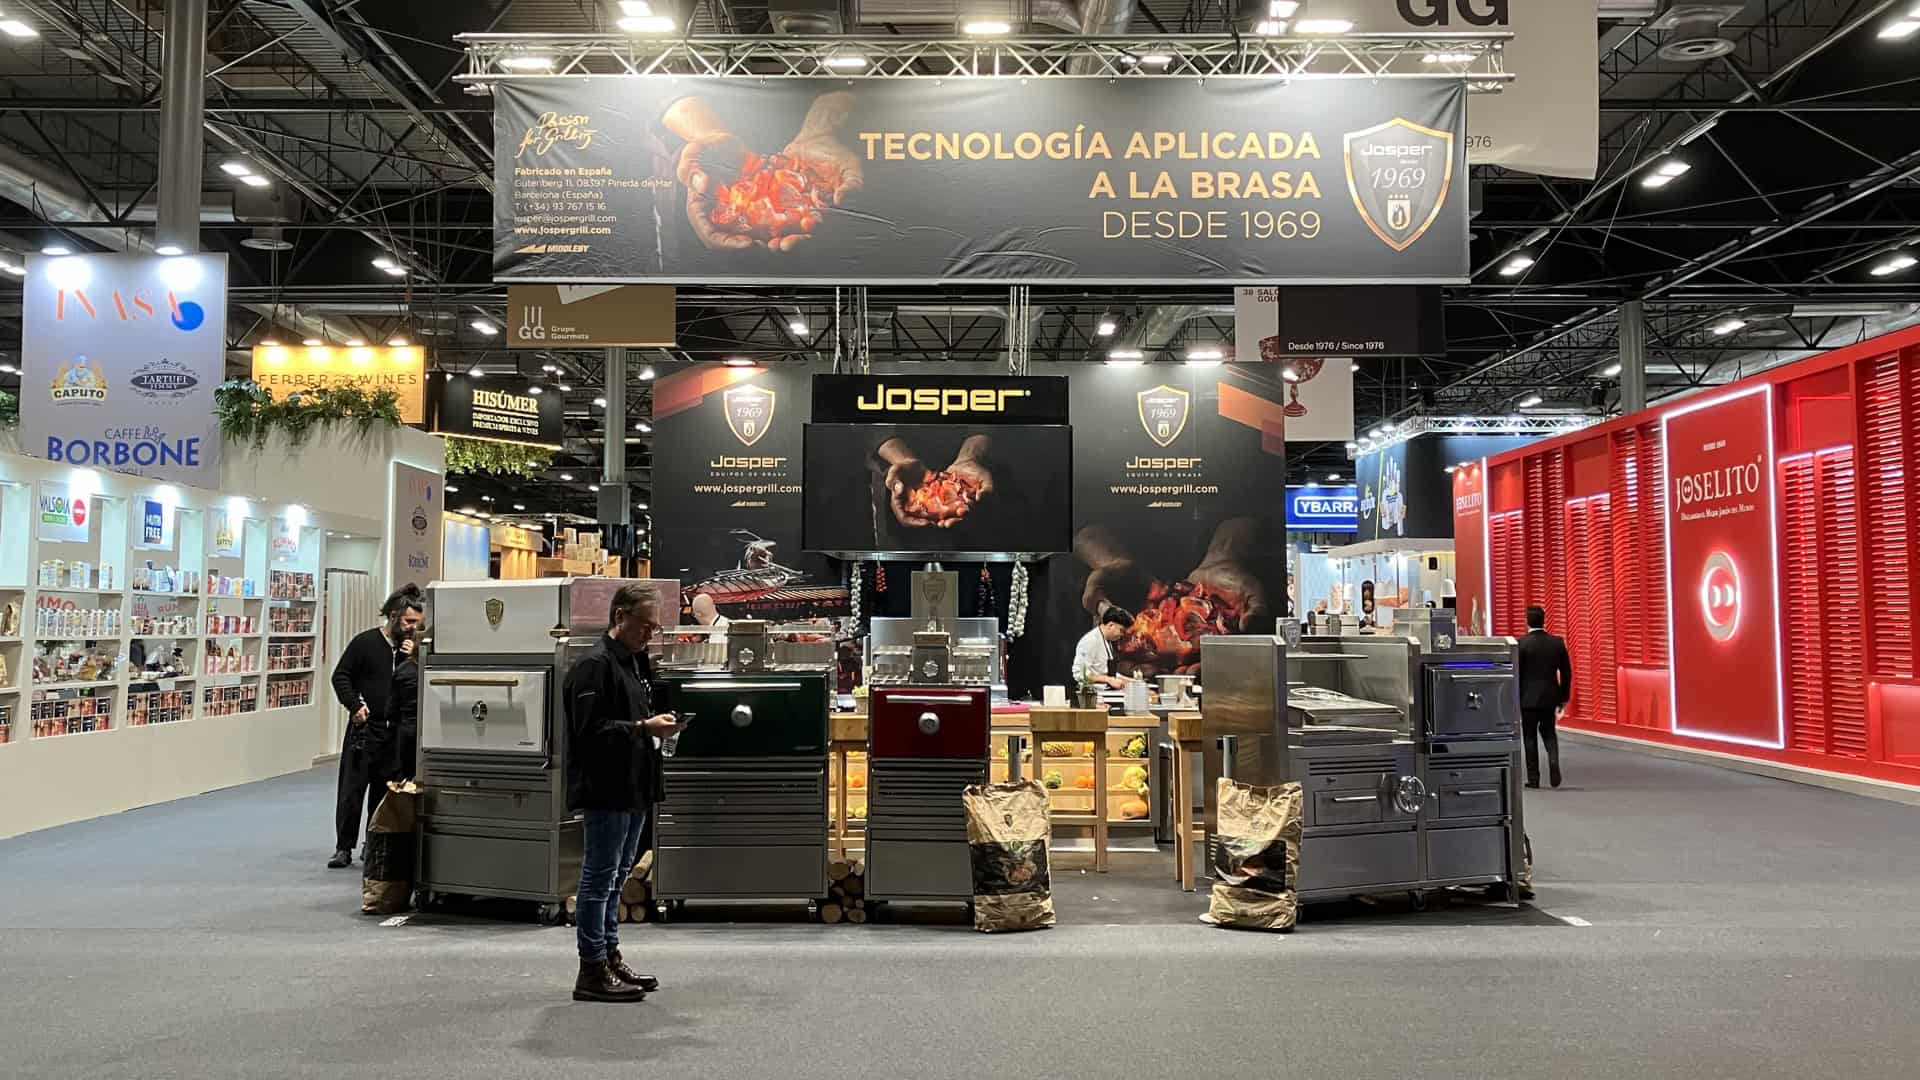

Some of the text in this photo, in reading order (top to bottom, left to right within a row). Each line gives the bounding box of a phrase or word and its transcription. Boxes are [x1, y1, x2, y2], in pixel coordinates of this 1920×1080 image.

[860, 123, 1321, 160] TECNOLOGÍA APLICADA
[1360, 144, 1432, 158] Josper
[514, 167, 612, 179] Fabricado en España
[1371, 168, 1425, 189] 1969
[514, 179, 563, 189] Gutenberg
[576, 179, 605, 188] 08397
[607, 179, 639, 188] Pineda
[655, 180, 673, 188] Mar
[1088, 171, 1321, 199] A LA BRASA
[514, 191, 603, 201] Barcelona (España)
[523, 203, 550, 212] (+34)
[552, 203, 564, 211] 93
[567, 203, 583, 211] 767
[586, 203, 595, 211] 15
[597, 203, 607, 211] 16
[514, 214, 617, 224] josper@jospergrill.com
[1102, 210, 1321, 239] DESDE 1969
[514, 225, 612, 236] www.jospergrill.com
[546, 244, 590, 253] MIDDLEBY
[518, 326, 546, 340] GG
[551, 326, 576, 334] Grupo
[1288, 342, 1314, 350] Desde
[1315, 342, 1334, 350] 1976
[1341, 342, 1364, 350] Since
[1365, 342, 1385, 350] 1976
[360, 374, 418, 385] WINES
[53, 388, 105, 399] CAPUTO
[857, 384, 1025, 415] Josper
[472, 389, 540, 413] HISÚMER
[1151, 407, 1177, 418] 1969
[47, 437, 200, 467] BORBONE
[710, 455, 787, 469] Josper
[1125, 455, 1202, 470] Josper
[694, 483, 802, 495] www.jospergrill.com
[1110, 483, 1219, 495] www.jospergrill.com
[1675, 463, 1760, 512] JOSELITO
[145, 527, 161, 538] FREE
